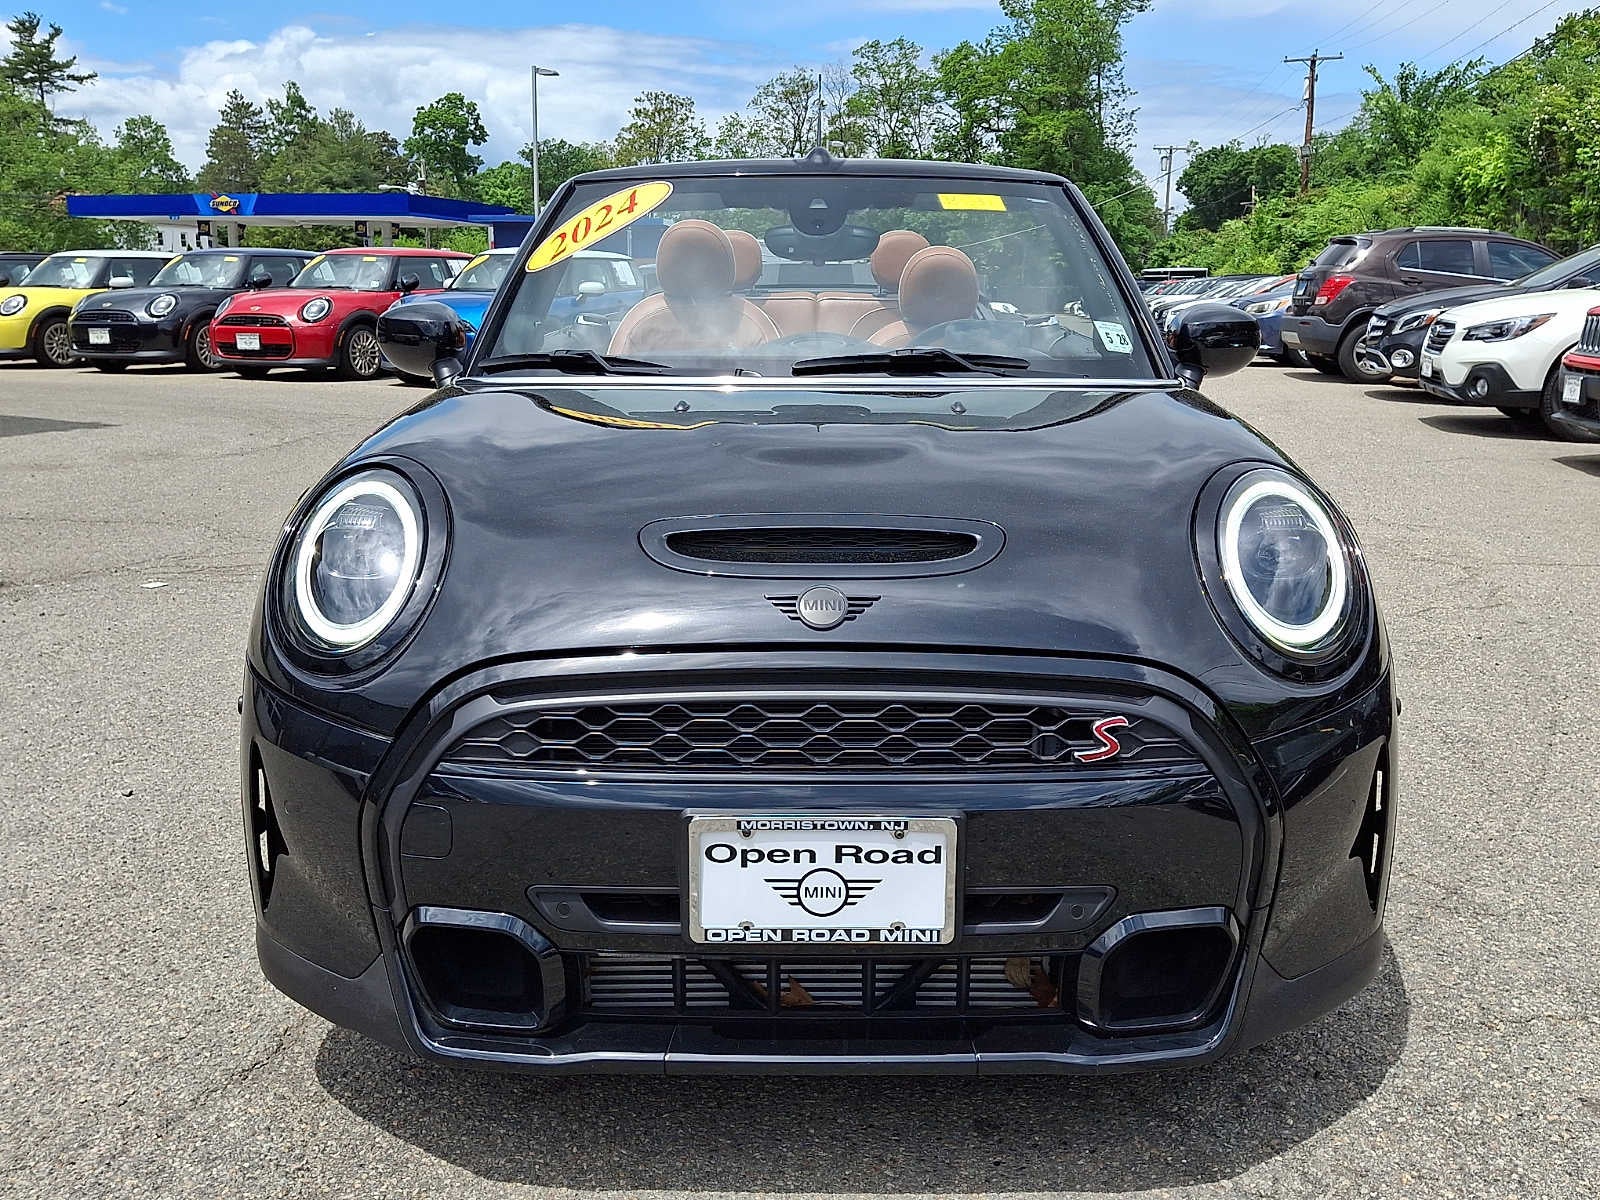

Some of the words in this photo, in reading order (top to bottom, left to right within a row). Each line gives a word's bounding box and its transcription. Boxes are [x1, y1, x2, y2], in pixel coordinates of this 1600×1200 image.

[550, 189, 639, 262] 2024
[1105, 332, 1113, 344] 5
[803, 599, 843, 611] MINI
[1074, 716, 1129, 763] S
[740, 820, 874, 830] MORRISTOWN,
[880, 820, 905, 830] NJ
[704, 843, 817, 868] Open
[835, 844, 942, 865] Road
[804, 886, 843, 899] MINI
[706, 929, 783, 942] OPEN
[792, 929, 870, 942] ROAD
[879, 929, 939, 942] MINI
